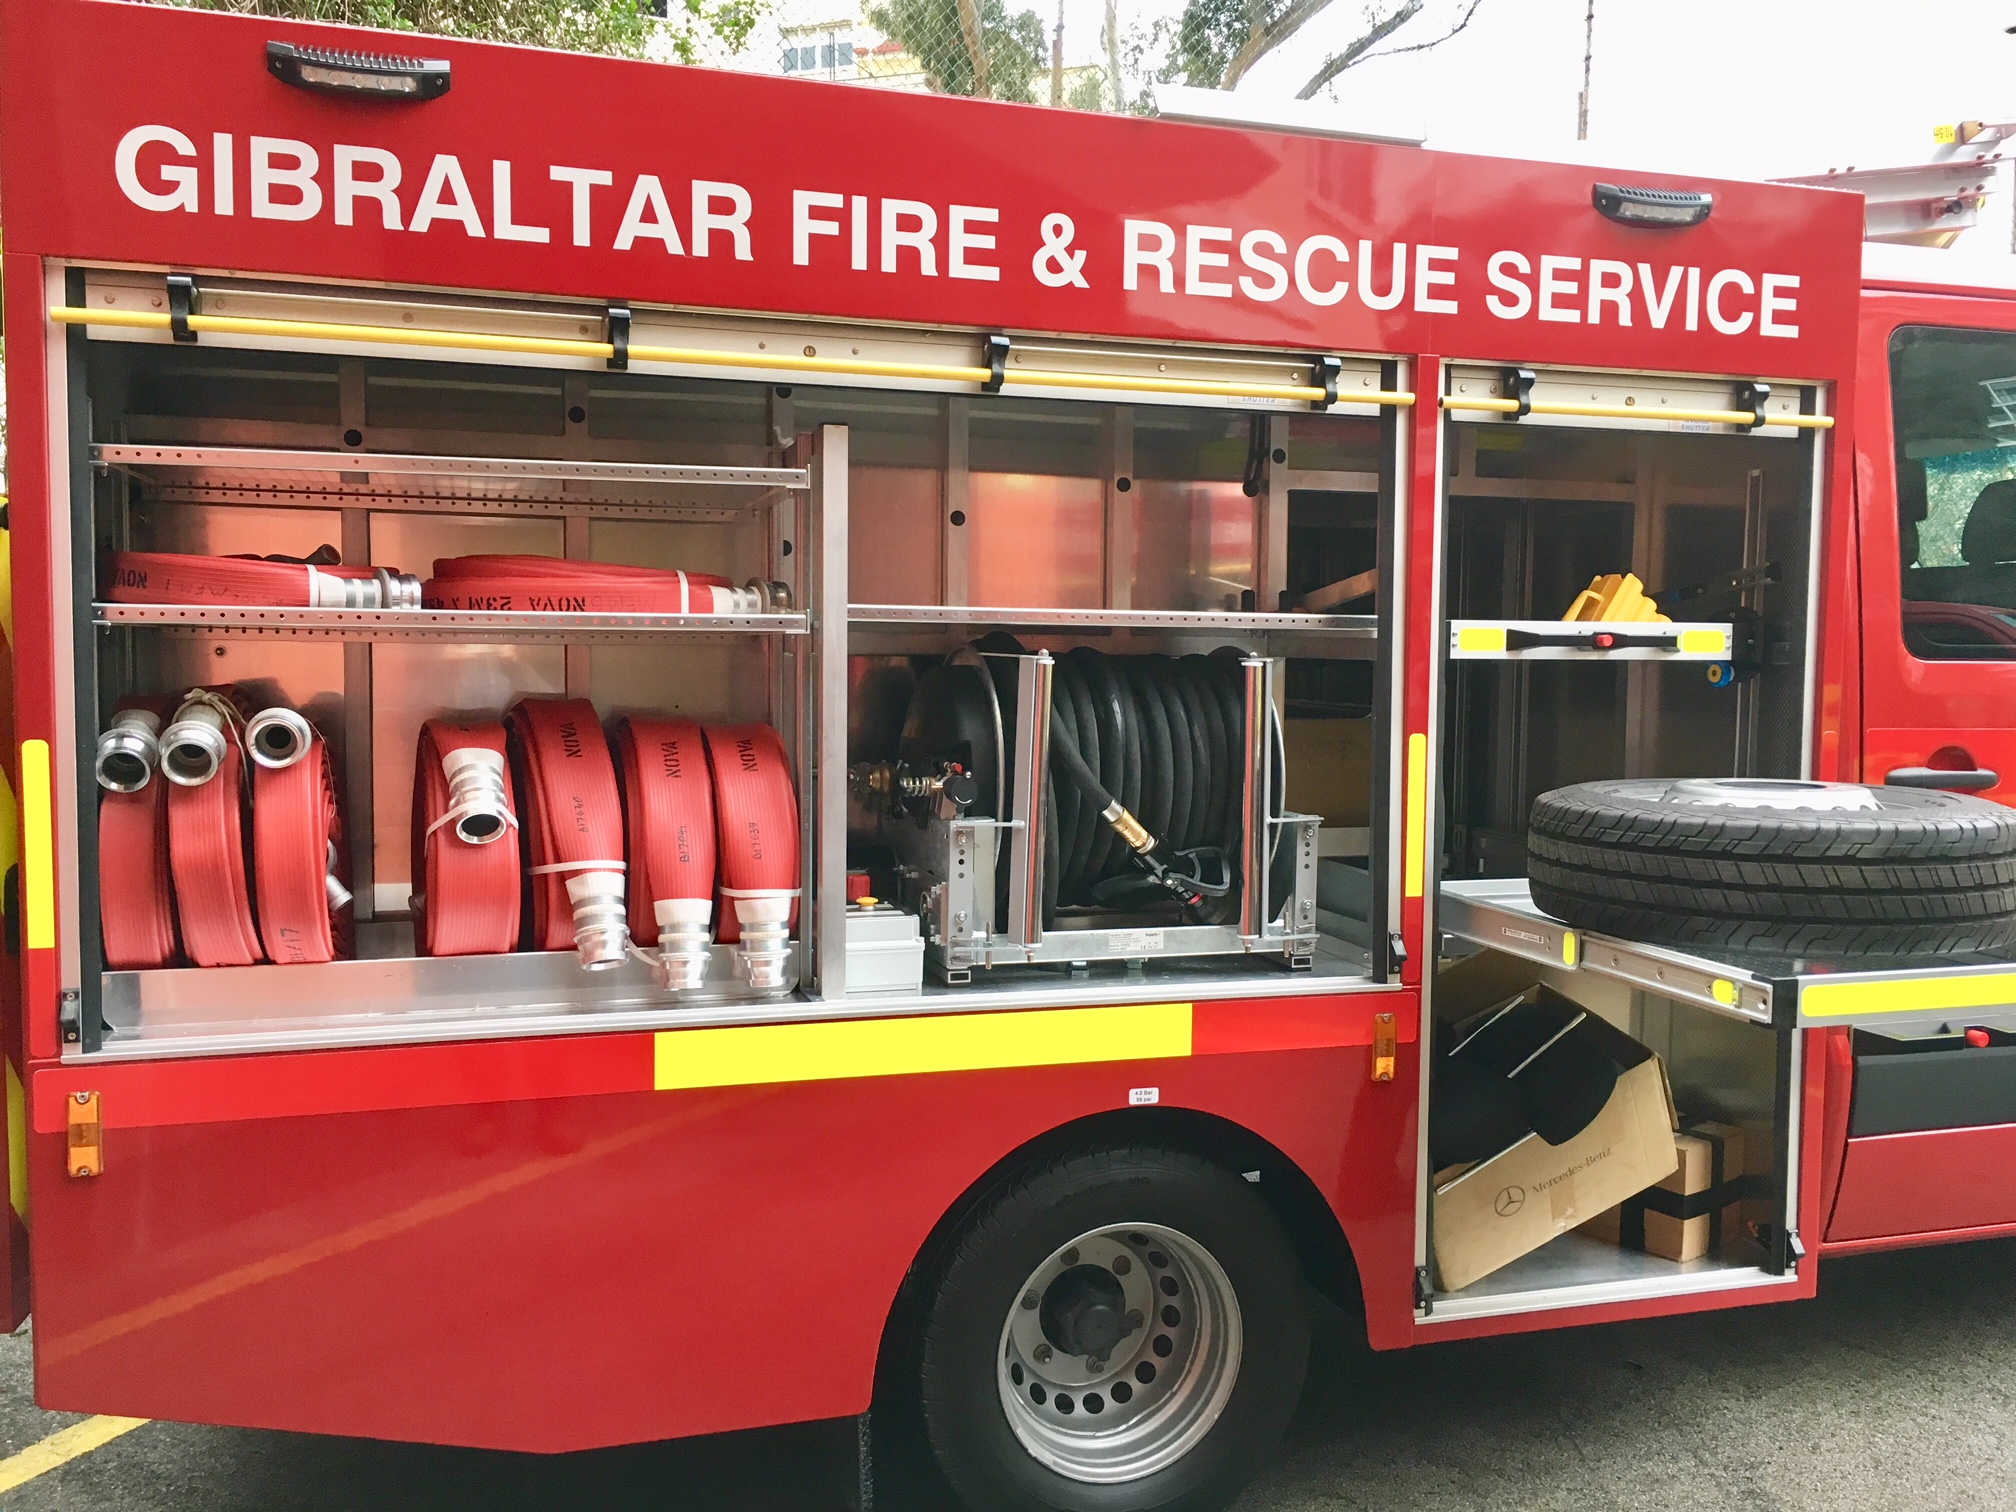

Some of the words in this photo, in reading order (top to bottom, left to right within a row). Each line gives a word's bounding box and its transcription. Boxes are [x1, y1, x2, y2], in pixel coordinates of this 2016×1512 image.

[115, 124, 753, 261] GIBRALTAR
[793, 189, 1001, 282] FIRE
[1032, 213, 1090, 288] &
[1123, 218, 1460, 315] RESCUE
[1485, 251, 1801, 339] SERVICE
[528, 596, 586, 612] NOVA
[560, 721, 583, 758] NOVA
[736, 739, 759, 772] NOVA
[661, 740, 682, 778] NOVA
[1532, 1147, 1612, 1195] Mercedes-Benz
